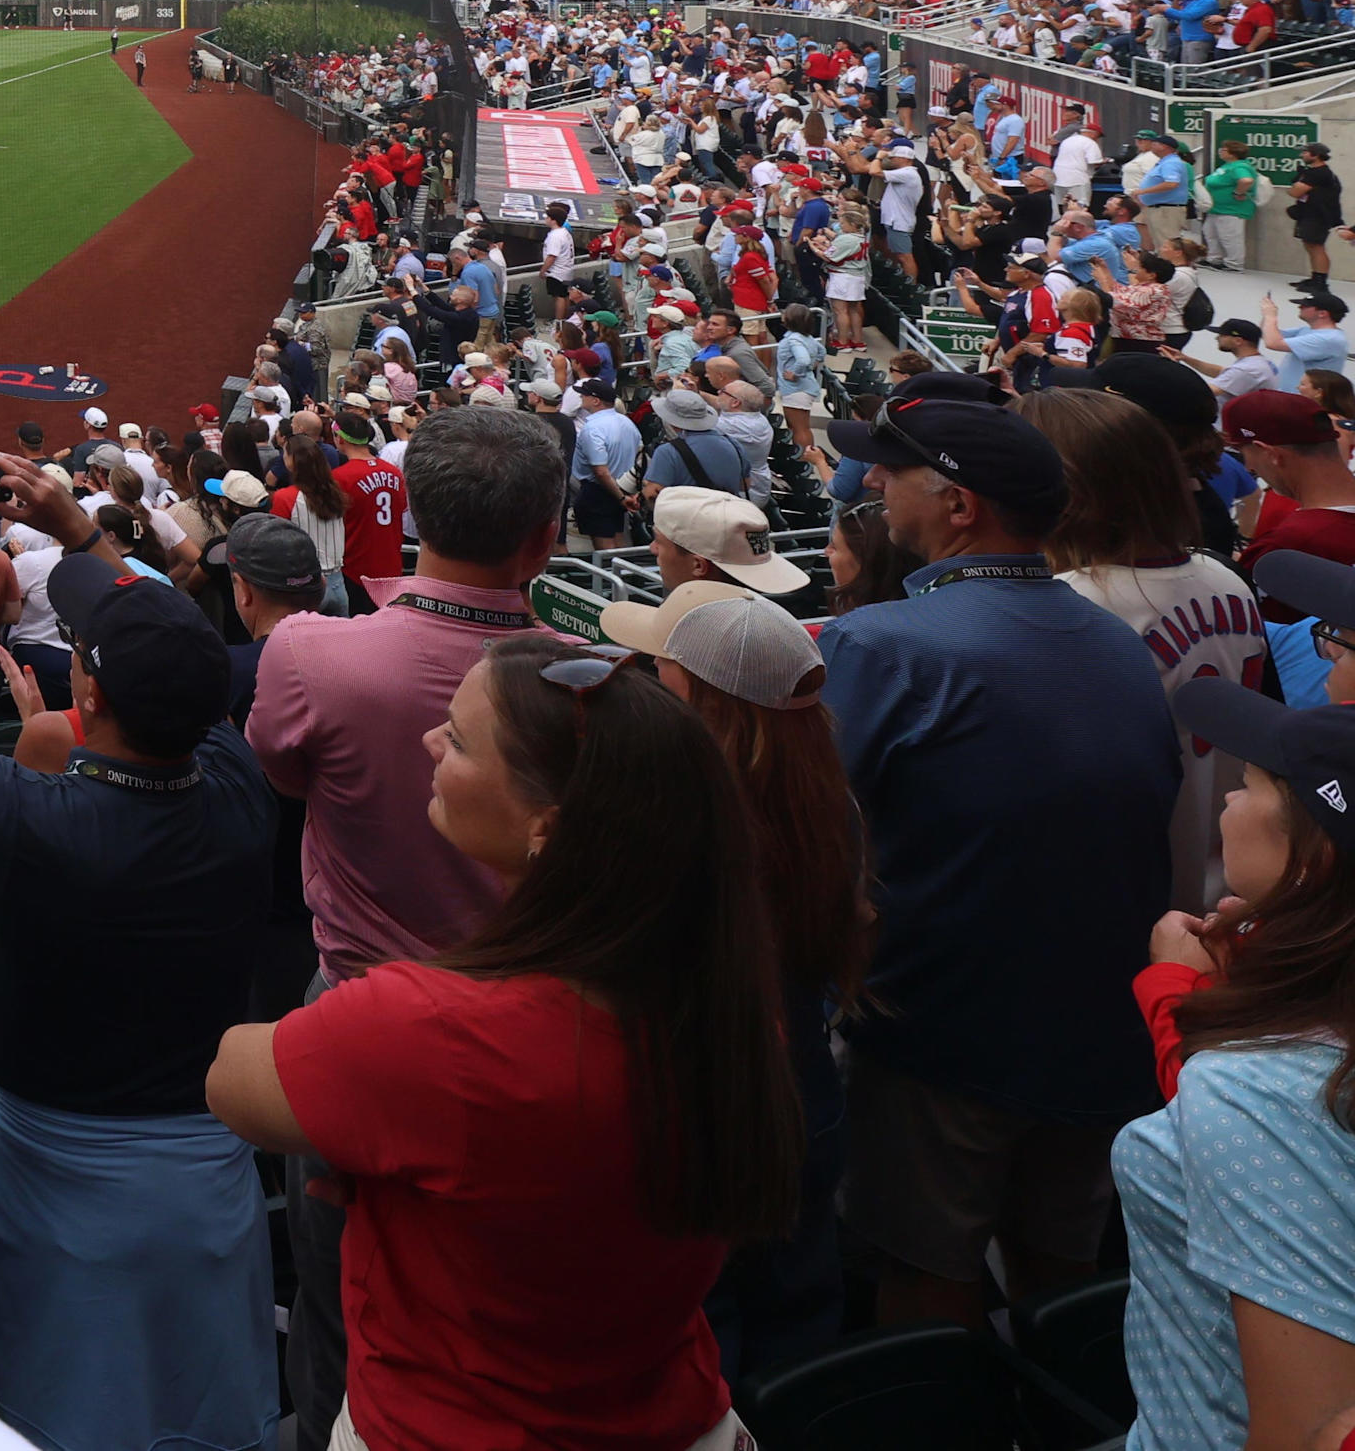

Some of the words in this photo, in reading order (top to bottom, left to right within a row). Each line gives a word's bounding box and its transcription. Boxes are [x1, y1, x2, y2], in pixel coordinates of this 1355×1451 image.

[156, 8, 174, 18] 335
[1183, 118, 1204, 131] 20
[1245, 133, 1308, 149] 101-104
[357, 471, 400, 495] HARPER
[376, 491, 392, 526] 3
[962, 566, 1011, 578] CALLING
[1011, 566, 1023, 577] IS
[415, 596, 436, 612] THE
[437, 600, 471, 619] FIELD
[474, 608, 485, 621] IS
[486, 611, 523, 627] CALLING
[554, 591, 577, 606] FIELD
[580, 603, 601, 617] DREA
[552, 608, 600, 641] SECTION
[1143, 594, 1264, 669] HALLADA
[107, 770, 153, 789] CALLING
[154, 780, 164, 790] IS
